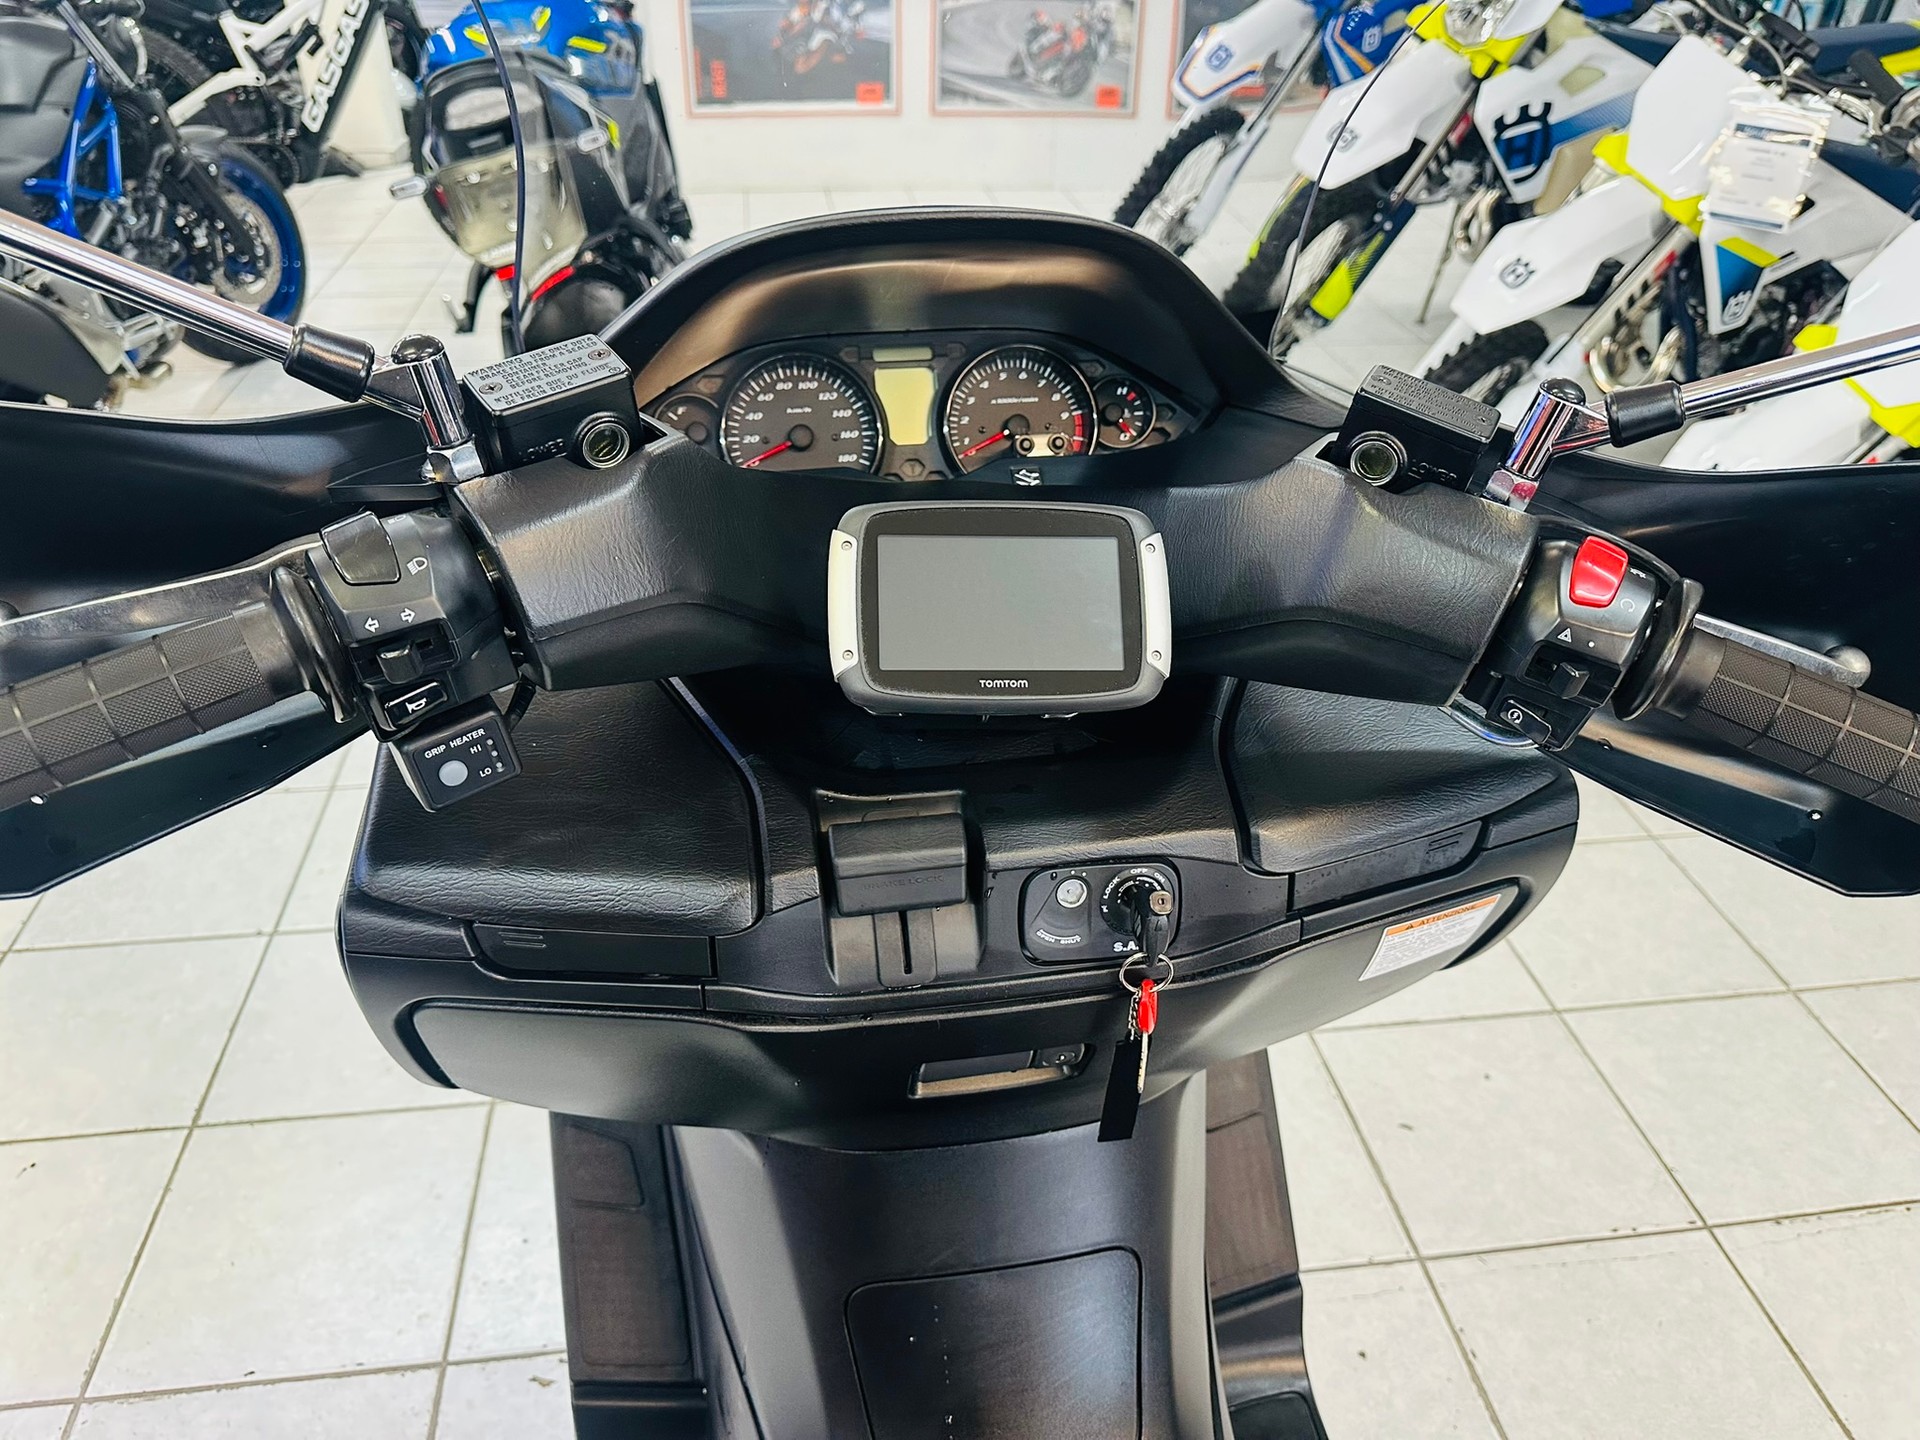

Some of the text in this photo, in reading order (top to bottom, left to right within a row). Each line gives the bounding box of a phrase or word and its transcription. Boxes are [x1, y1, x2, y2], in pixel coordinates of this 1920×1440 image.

[301, 0, 370, 133] GASGAS
[468, 357, 522, 376] WARNING
[530, 350, 547, 359] USE
[549, 343, 568, 353] ONLY
[479, 368, 508, 381] BRAKE
[509, 360, 533, 372] FLUID
[534, 353, 557, 364] FROM
[566, 341, 598, 354] SEALED
[506, 356, 583, 385] CLEAN FILLER CAP
[546, 378, 564, 387] QUE
[566, 373, 579, 381] DU
[581, 363, 611, 376] FLUIDE
[510, 375, 544, 389] BEFORE
[544, 362, 591, 379] REMOVING.
[999, 372, 1008, 380] 5
[1018, 371, 1028, 380] 6
[776, 382, 792, 390] 80
[798, 381, 818, 389] 100
[979, 380, 990, 389] 4
[1037, 379, 1047, 387] 7
[1117, 386, 1127, 395] H
[505, 398, 517, 406] DE
[520, 390, 547, 401] FREIN
[757, 393, 774, 401] 60
[819, 391, 838, 400] 120
[1051, 393, 1061, 402] 8
[966, 397, 976, 405] 3
[745, 412, 763, 420] 40
[832, 409, 852, 418] 140
[1060, 411, 1070, 420] 9
[960, 416, 970, 424] 2
[743, 435, 760, 443] 20
[840, 430, 859, 439] 160
[963, 437, 970, 445] 1
[838, 454, 857, 462] 180
[979, 679, 1029, 688] TOMTOM
[424, 728, 486, 759] GRIP HEATER
[469, 743, 482, 755] HI
[480, 767, 492, 778] LO
[1154, 872, 1165, 883] ON
[1103, 876, 1121, 899] LOCK
[1036, 930, 1055, 943] OPEN
